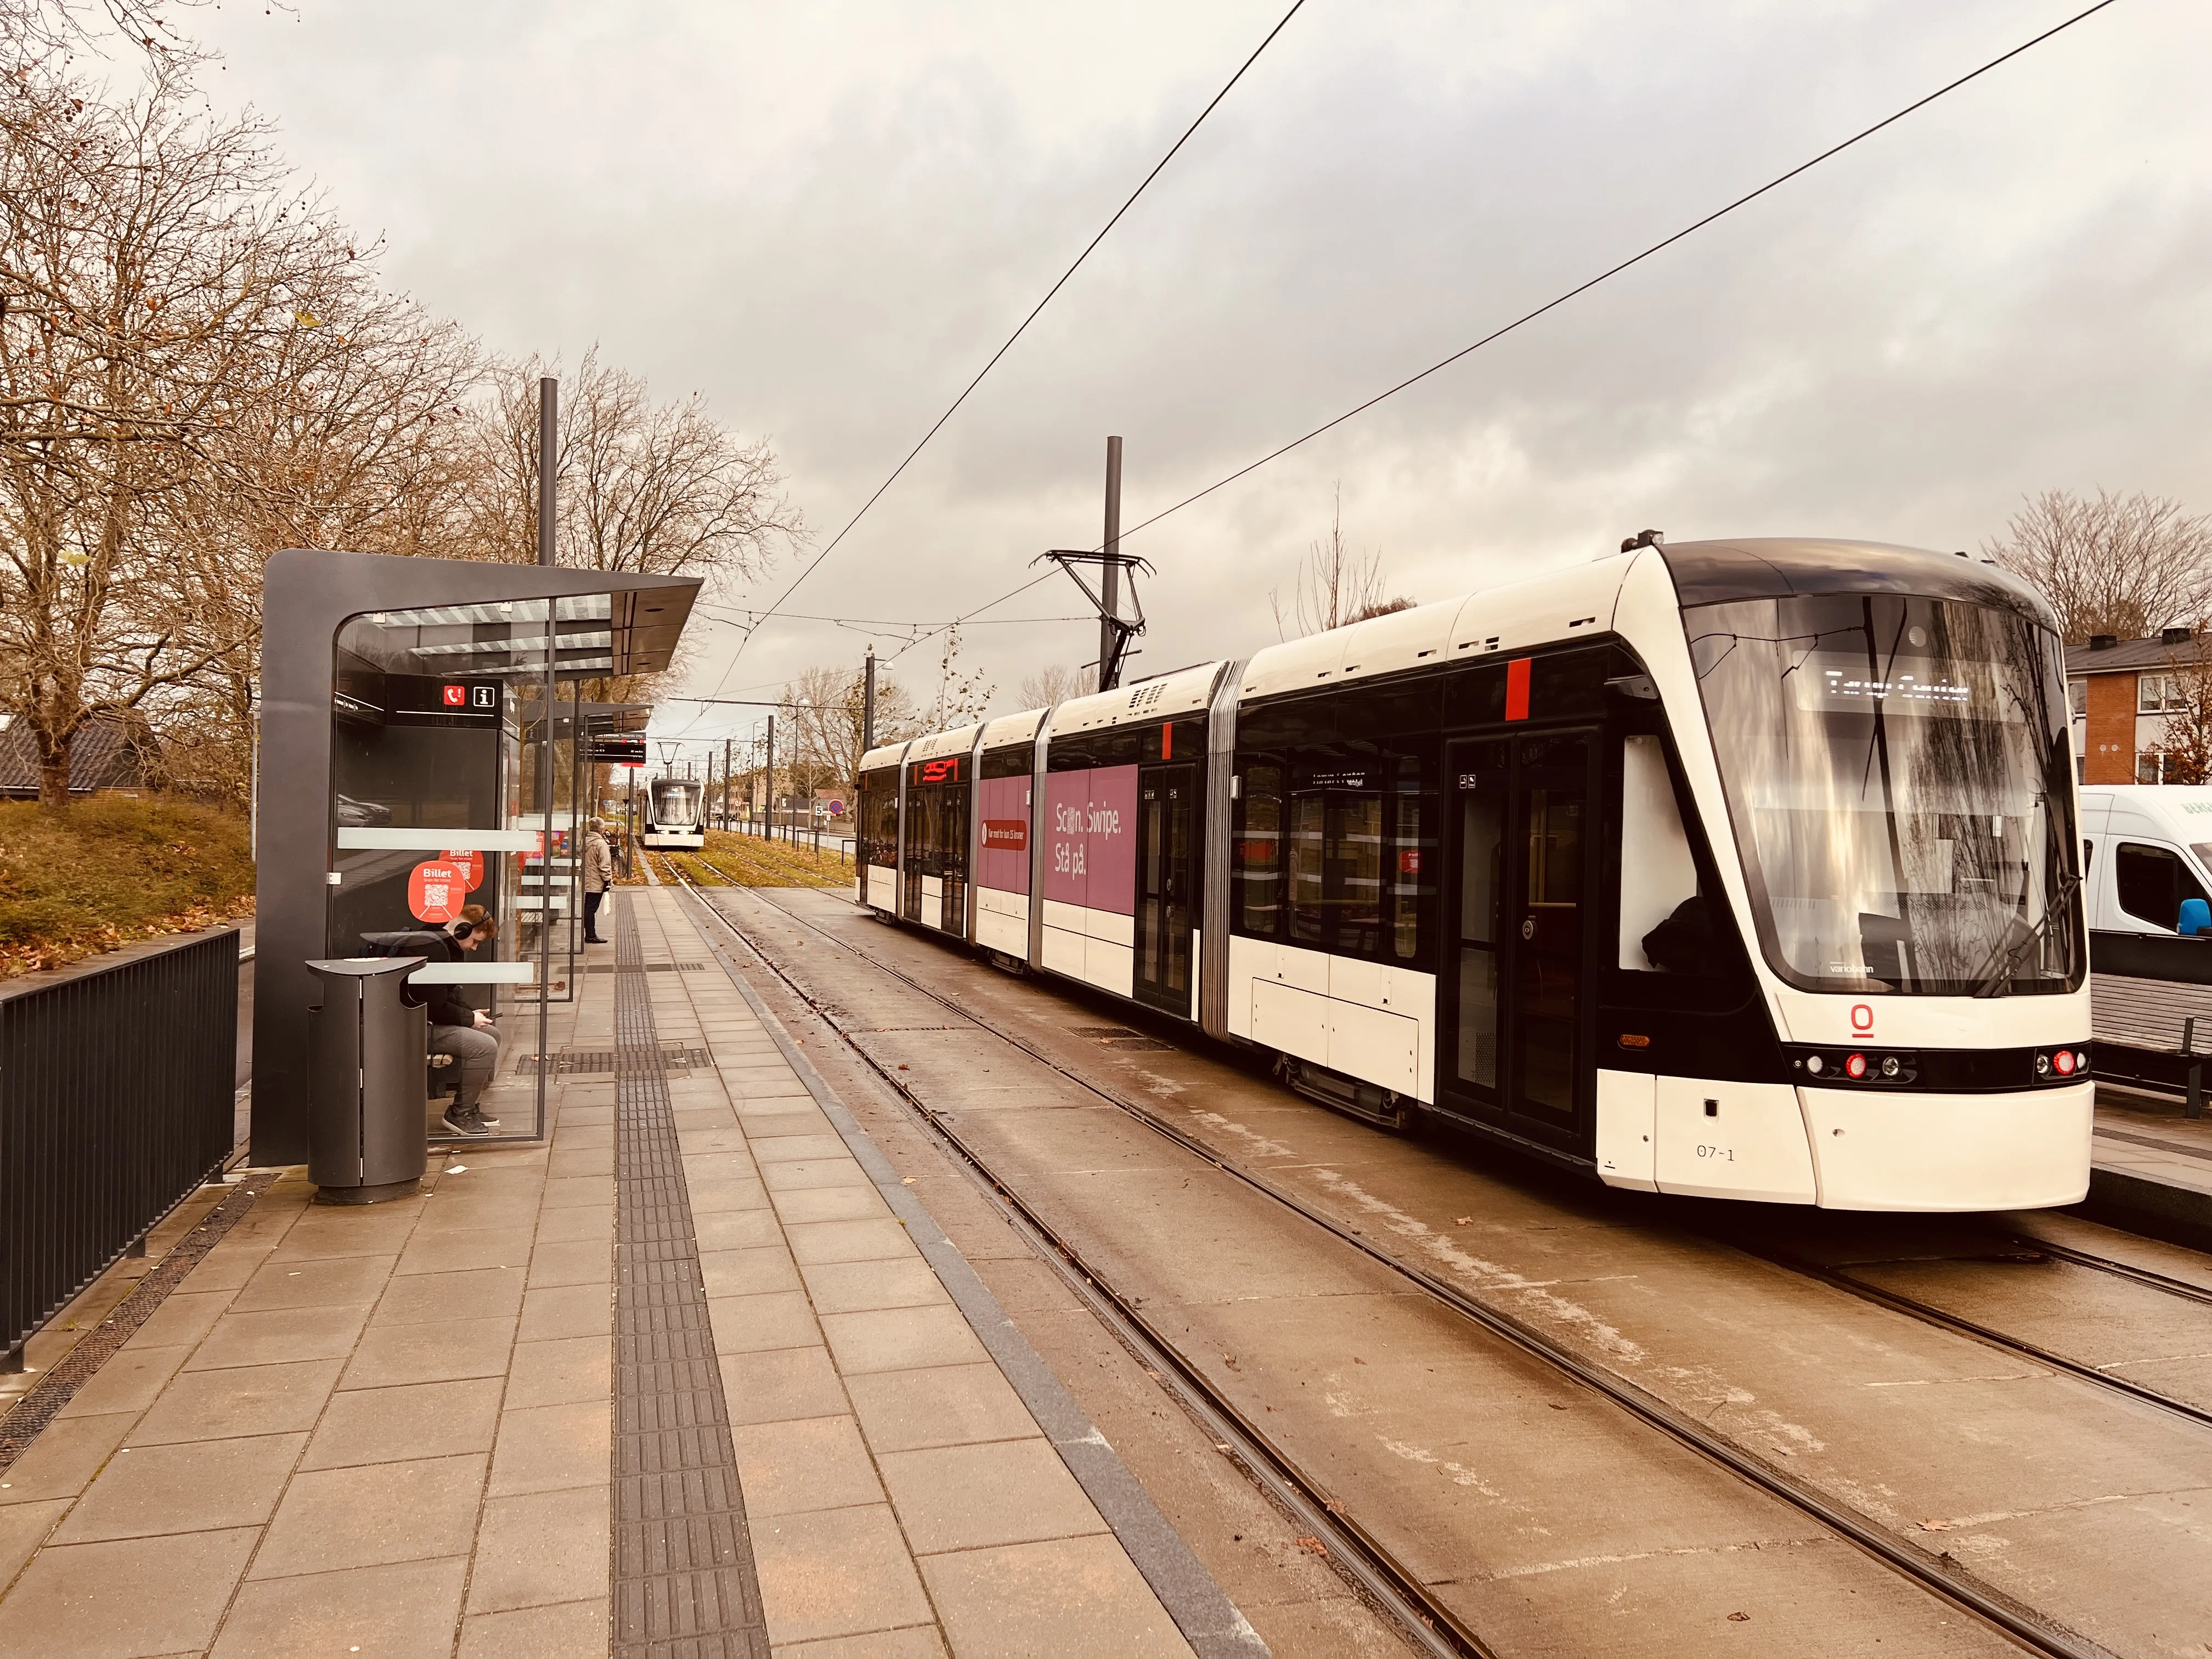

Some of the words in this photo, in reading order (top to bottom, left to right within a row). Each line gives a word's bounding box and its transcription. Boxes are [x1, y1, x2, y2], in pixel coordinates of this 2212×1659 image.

[1087, 800, 1121, 840] Swipe.
[1054, 842, 1070, 872] Stå
[1072, 843, 1086, 881] på.
[423, 868, 452, 878] Billet
[1830, 964, 1874, 973] variobahn
[1697, 1145, 1734, 1161] 07-1
